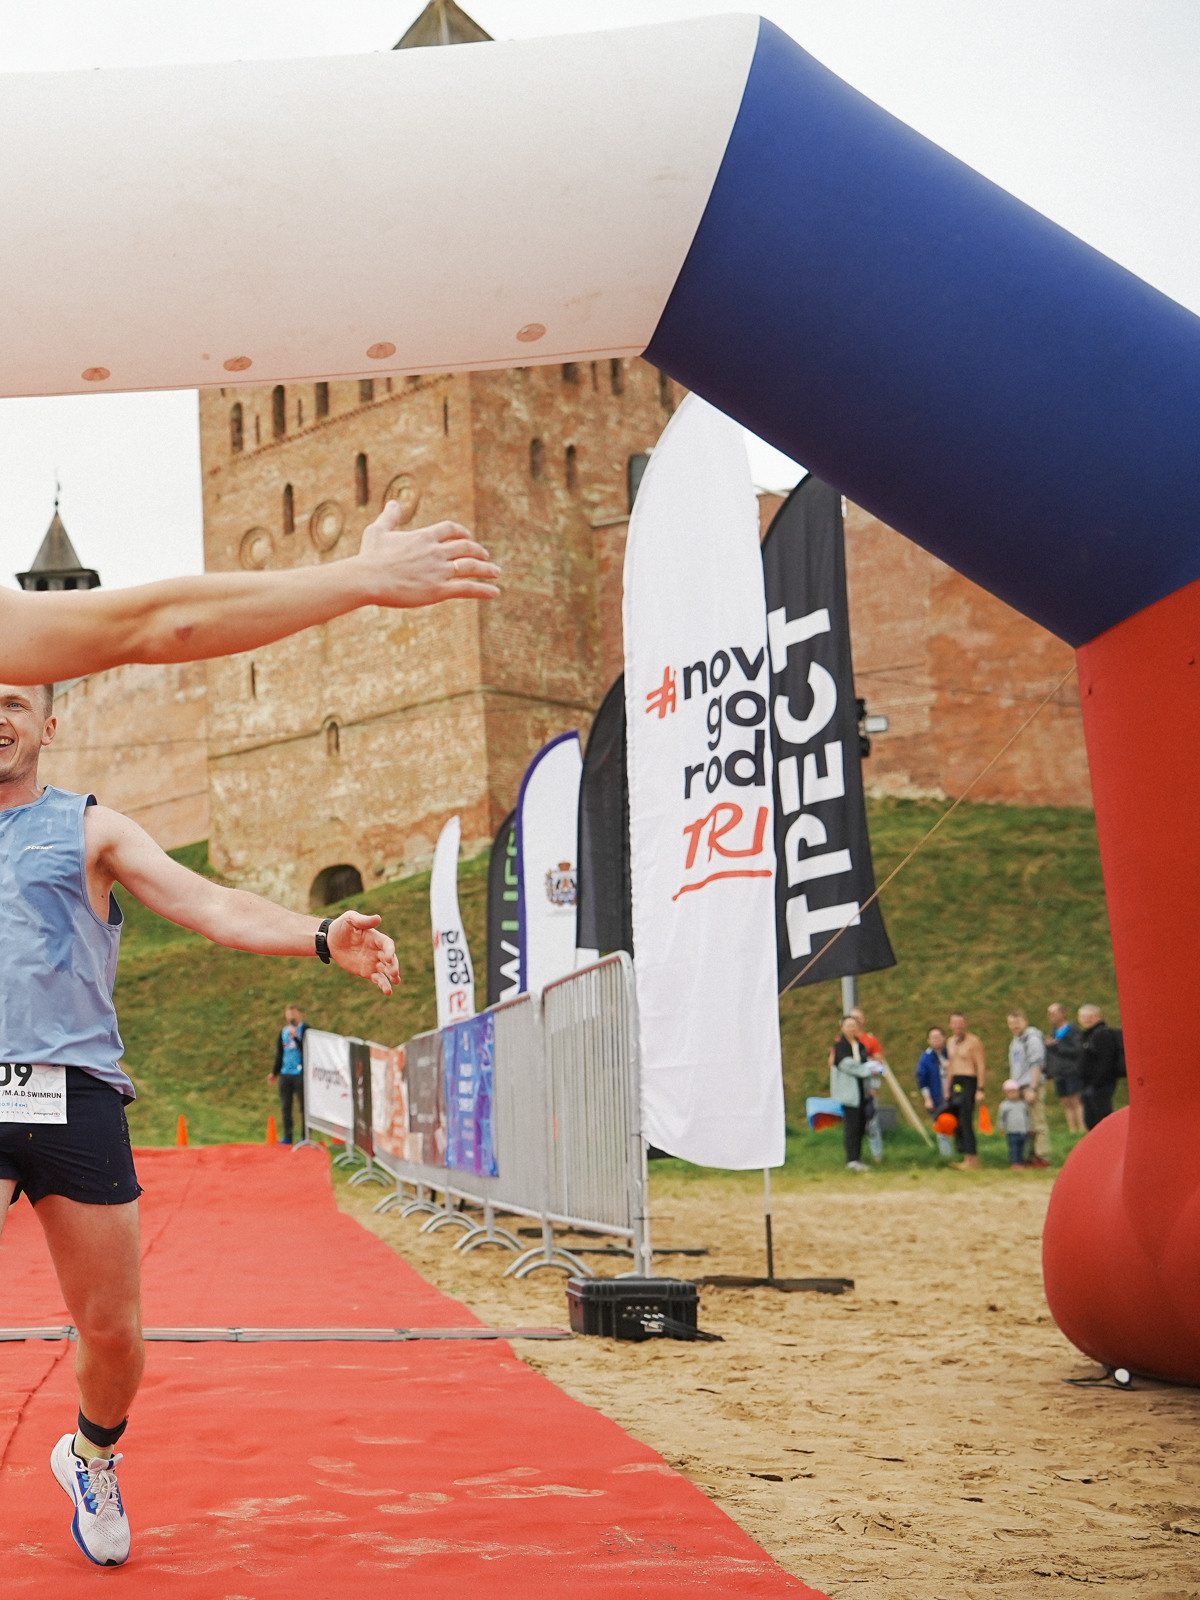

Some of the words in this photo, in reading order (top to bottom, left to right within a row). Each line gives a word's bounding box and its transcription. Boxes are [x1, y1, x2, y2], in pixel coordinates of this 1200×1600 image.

[646, 646, 766, 719] #nov
[707, 690, 766, 750] go
[684, 729, 766, 799] rod
[683, 802, 769, 870] TRI
